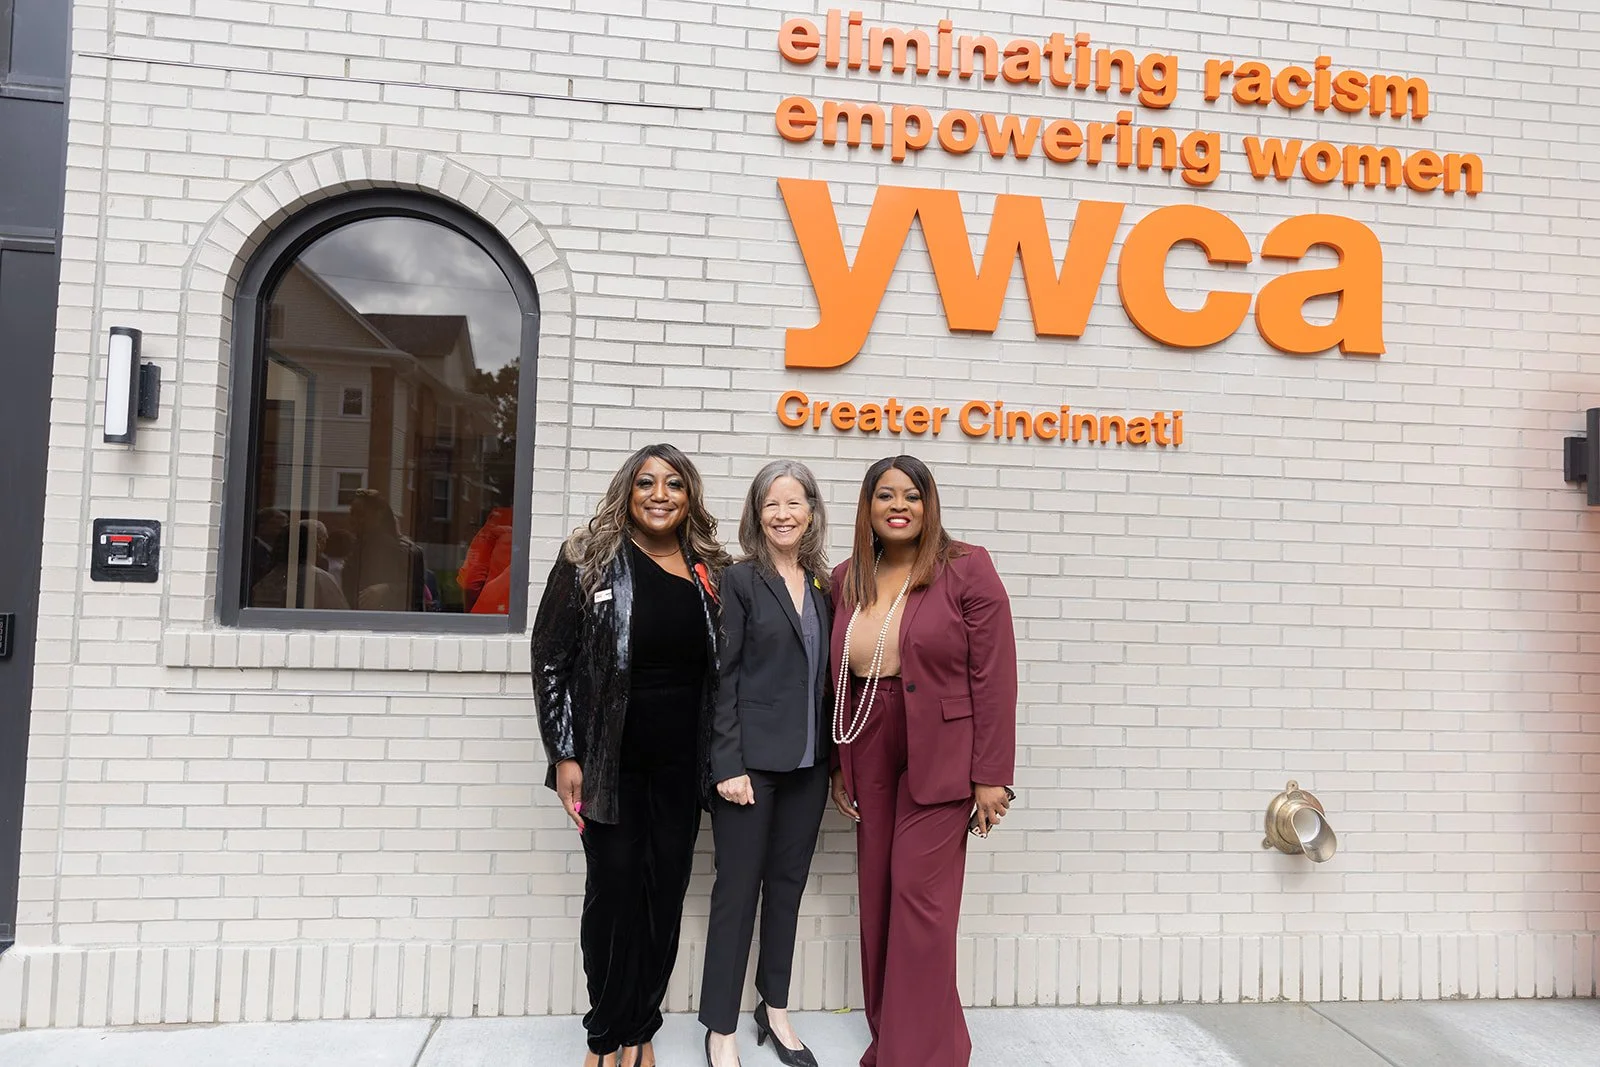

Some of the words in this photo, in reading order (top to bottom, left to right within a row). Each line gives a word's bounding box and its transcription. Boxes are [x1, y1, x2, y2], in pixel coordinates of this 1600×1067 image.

[778, 9, 1178, 109] eliminating
[1204, 56, 1429, 120] racism
[776, 96, 1221, 188] empowering
[1243, 136, 1483, 196] women
[777, 177, 1386, 370] ywca
[777, 390, 950, 436] Greater
[959, 400, 1183, 447] Cincinnati
